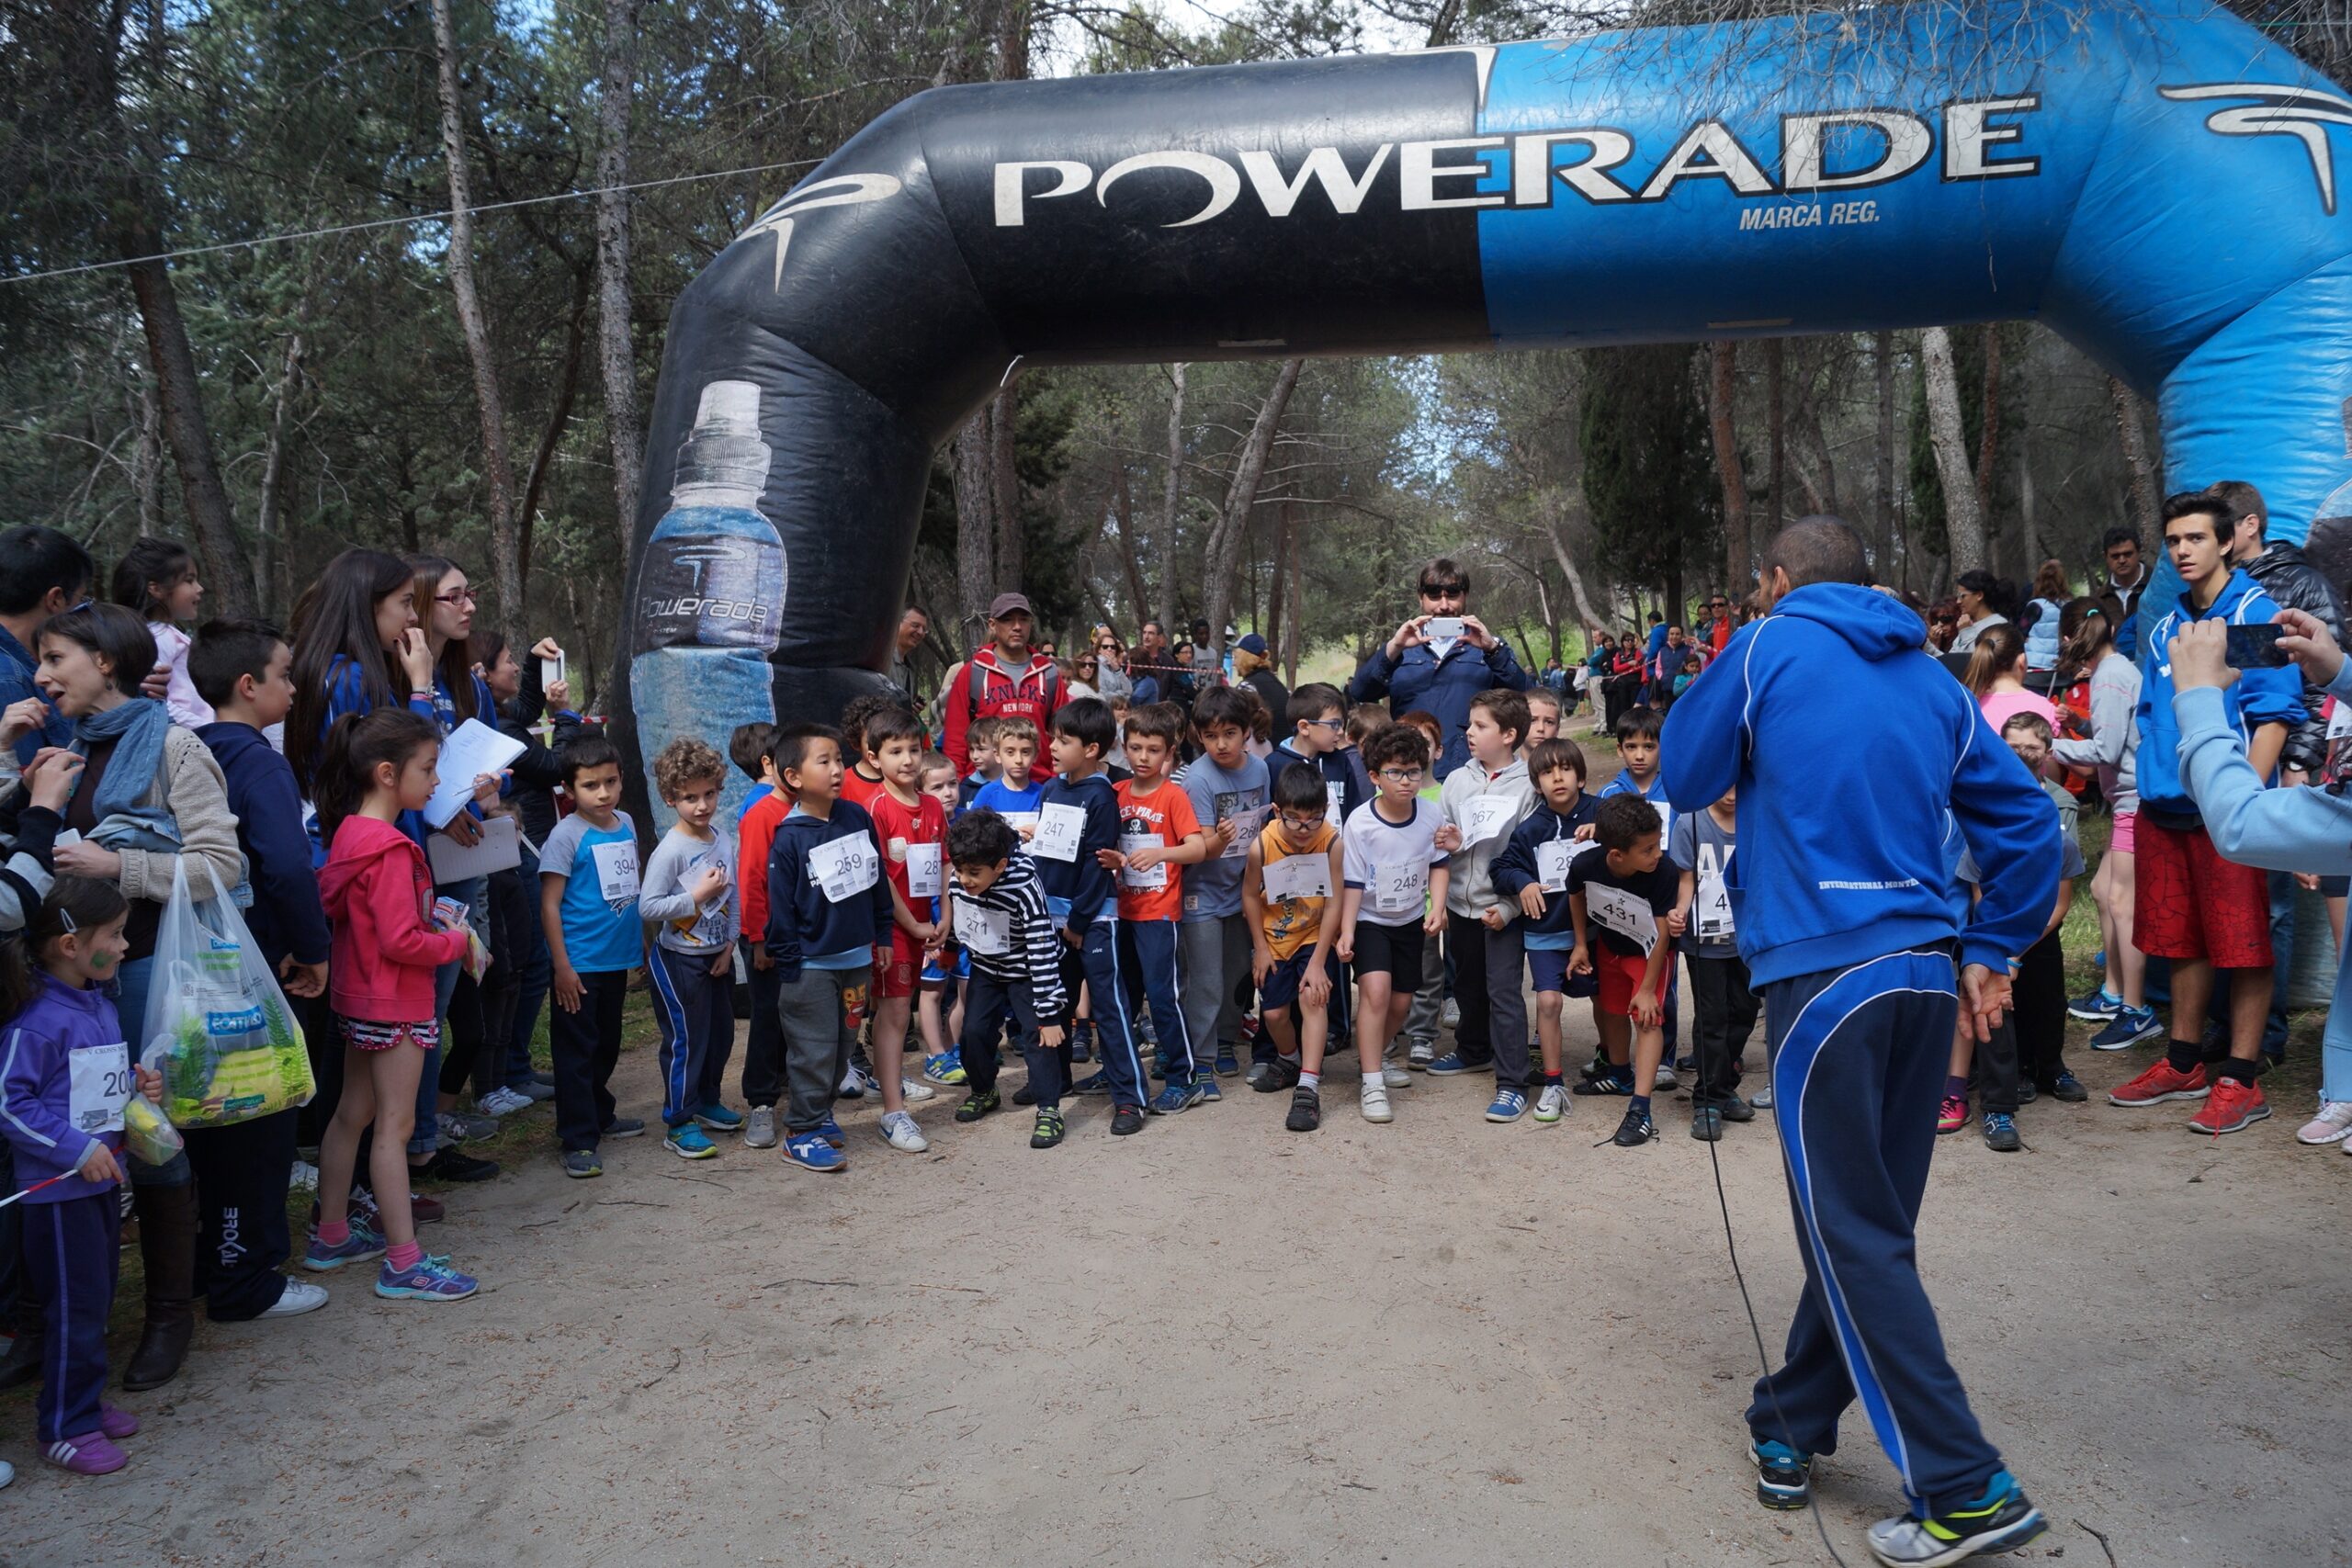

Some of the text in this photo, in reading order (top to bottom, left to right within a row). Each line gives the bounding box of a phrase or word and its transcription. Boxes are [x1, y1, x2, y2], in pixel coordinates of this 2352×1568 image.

[994, 95, 2041, 229] POWERADE
[1739, 200, 1881, 231] MARCA REG.
[985, 679, 1046, 705] KNICKS
[1002, 702, 1017, 713] NEW
[1136, 806, 1165, 824] PIRATE
[1472, 810, 1496, 827] 267
[1044, 820, 1065, 837] 247
[614, 858, 636, 876] 394
[834, 852, 862, 876] 259
[1393, 874, 1418, 892] 248
[1819, 880, 1883, 890] INTERNATIONAL
[1603, 904, 1636, 926] 431
[966, 917, 988, 936] 271
